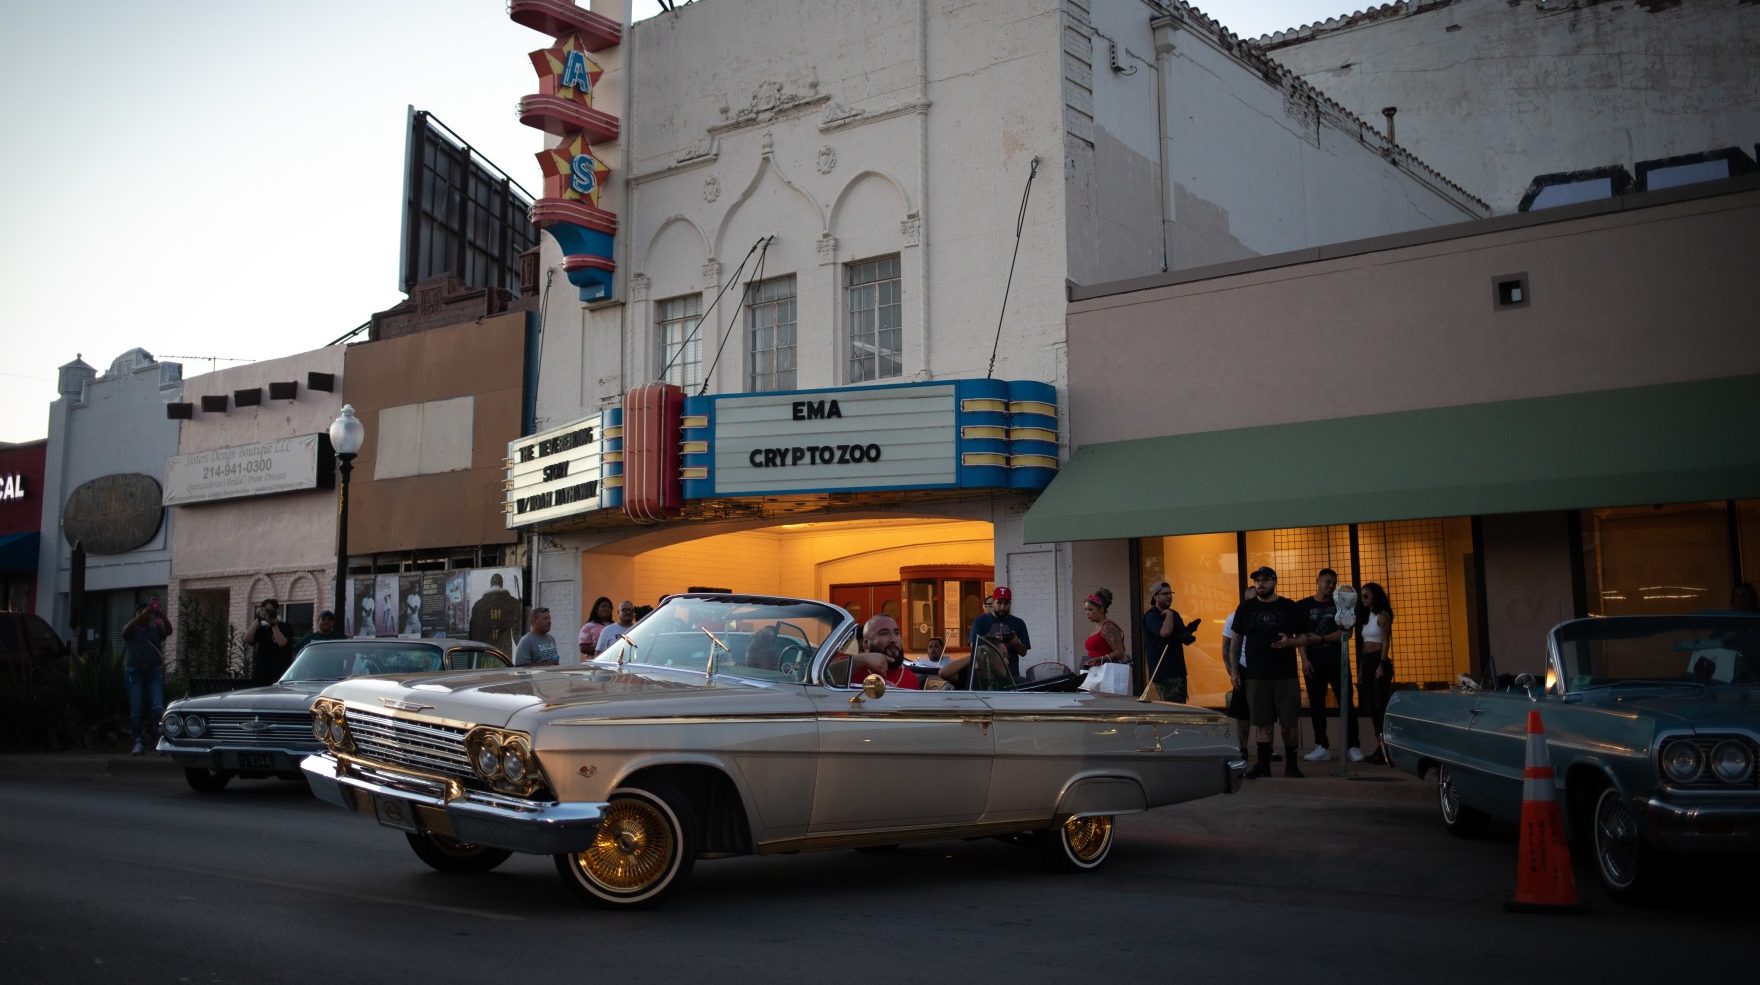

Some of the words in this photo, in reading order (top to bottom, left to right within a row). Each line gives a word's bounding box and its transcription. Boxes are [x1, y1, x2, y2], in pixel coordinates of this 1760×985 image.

[792, 400, 842, 421] EMA
[238, 445, 272, 459] Boutique
[519, 444, 535, 463] THE
[538, 427, 593, 458] NEVERENDING
[749, 443, 881, 468] CRYPTOZOO
[203, 458, 272, 479] 214-941-0300
[543, 461, 569, 482] STORY
[555, 479, 598, 506] HATHAWAY
[490, 608, 502, 620] SAY
